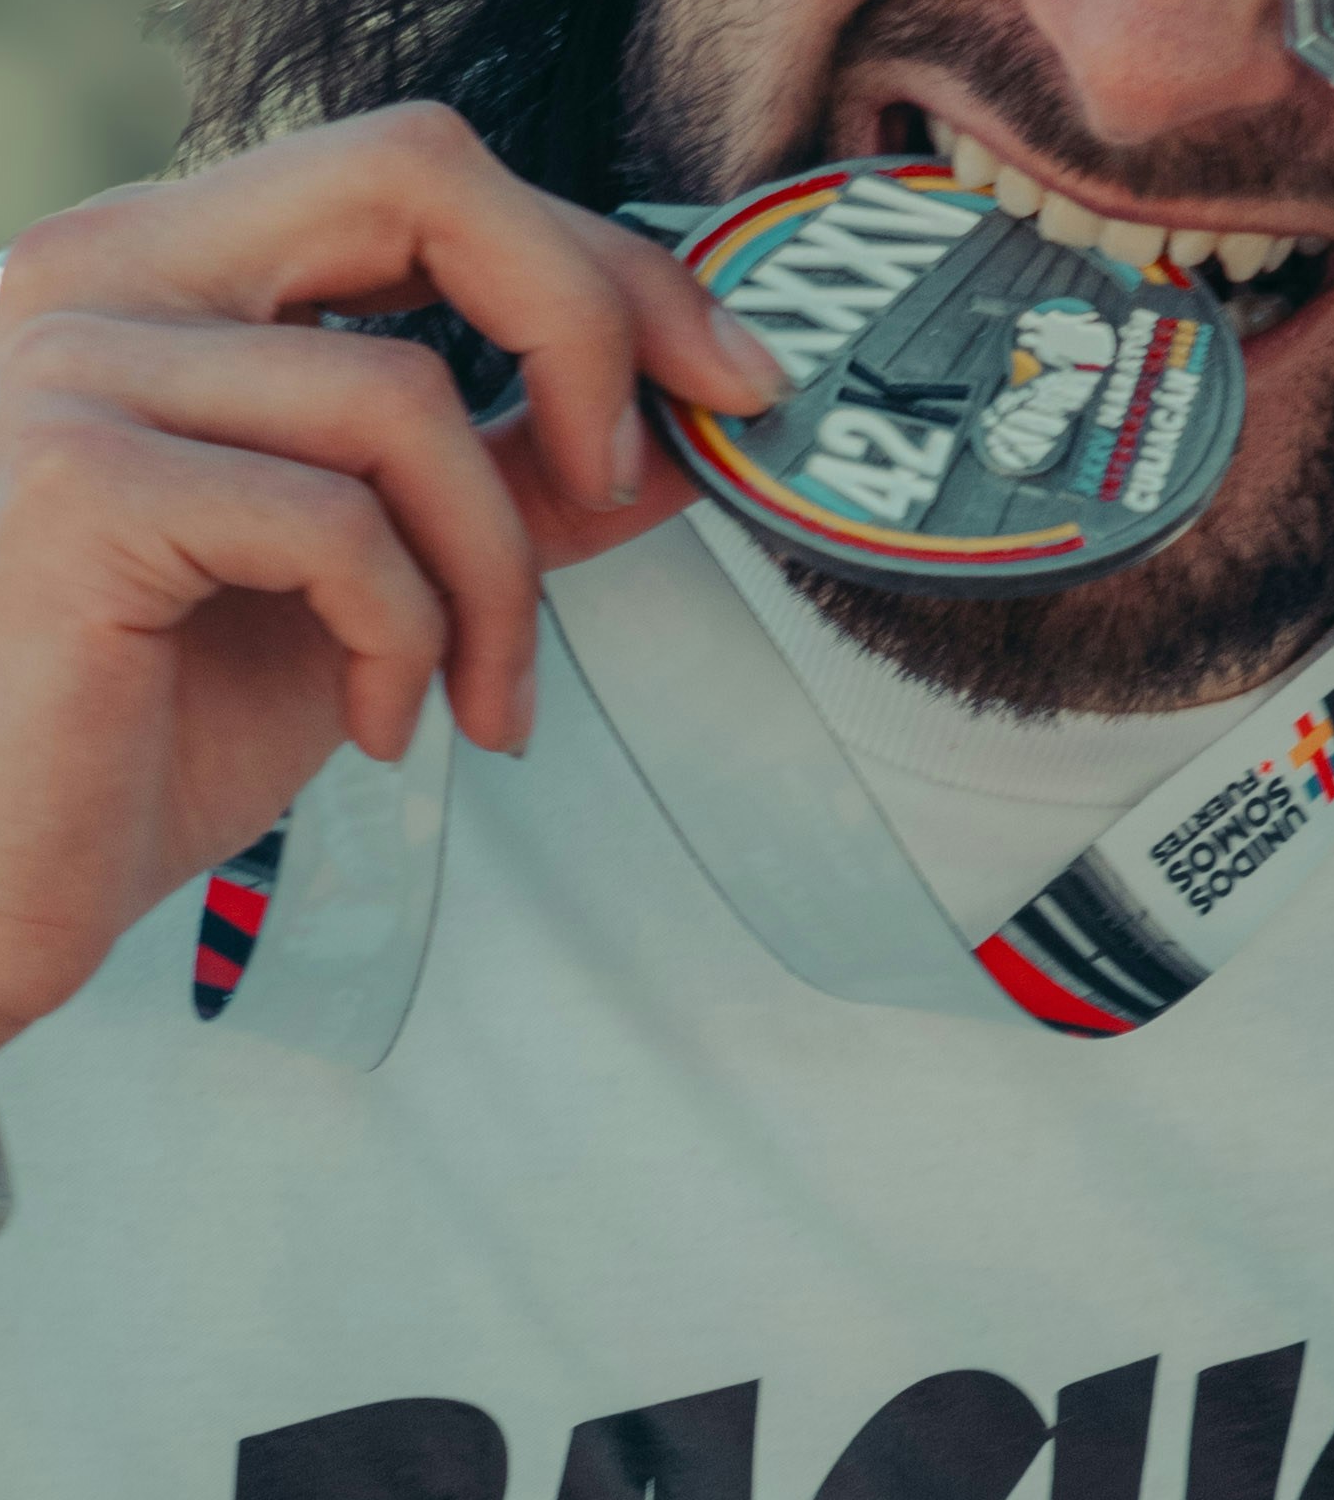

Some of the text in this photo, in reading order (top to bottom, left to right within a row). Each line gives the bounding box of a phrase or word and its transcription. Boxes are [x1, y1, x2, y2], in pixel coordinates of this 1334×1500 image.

[805, 358, 973, 522] 42K
[1166, 774, 1292, 895] SOMOS
[1188, 804, 1310, 918] UNIDOS
